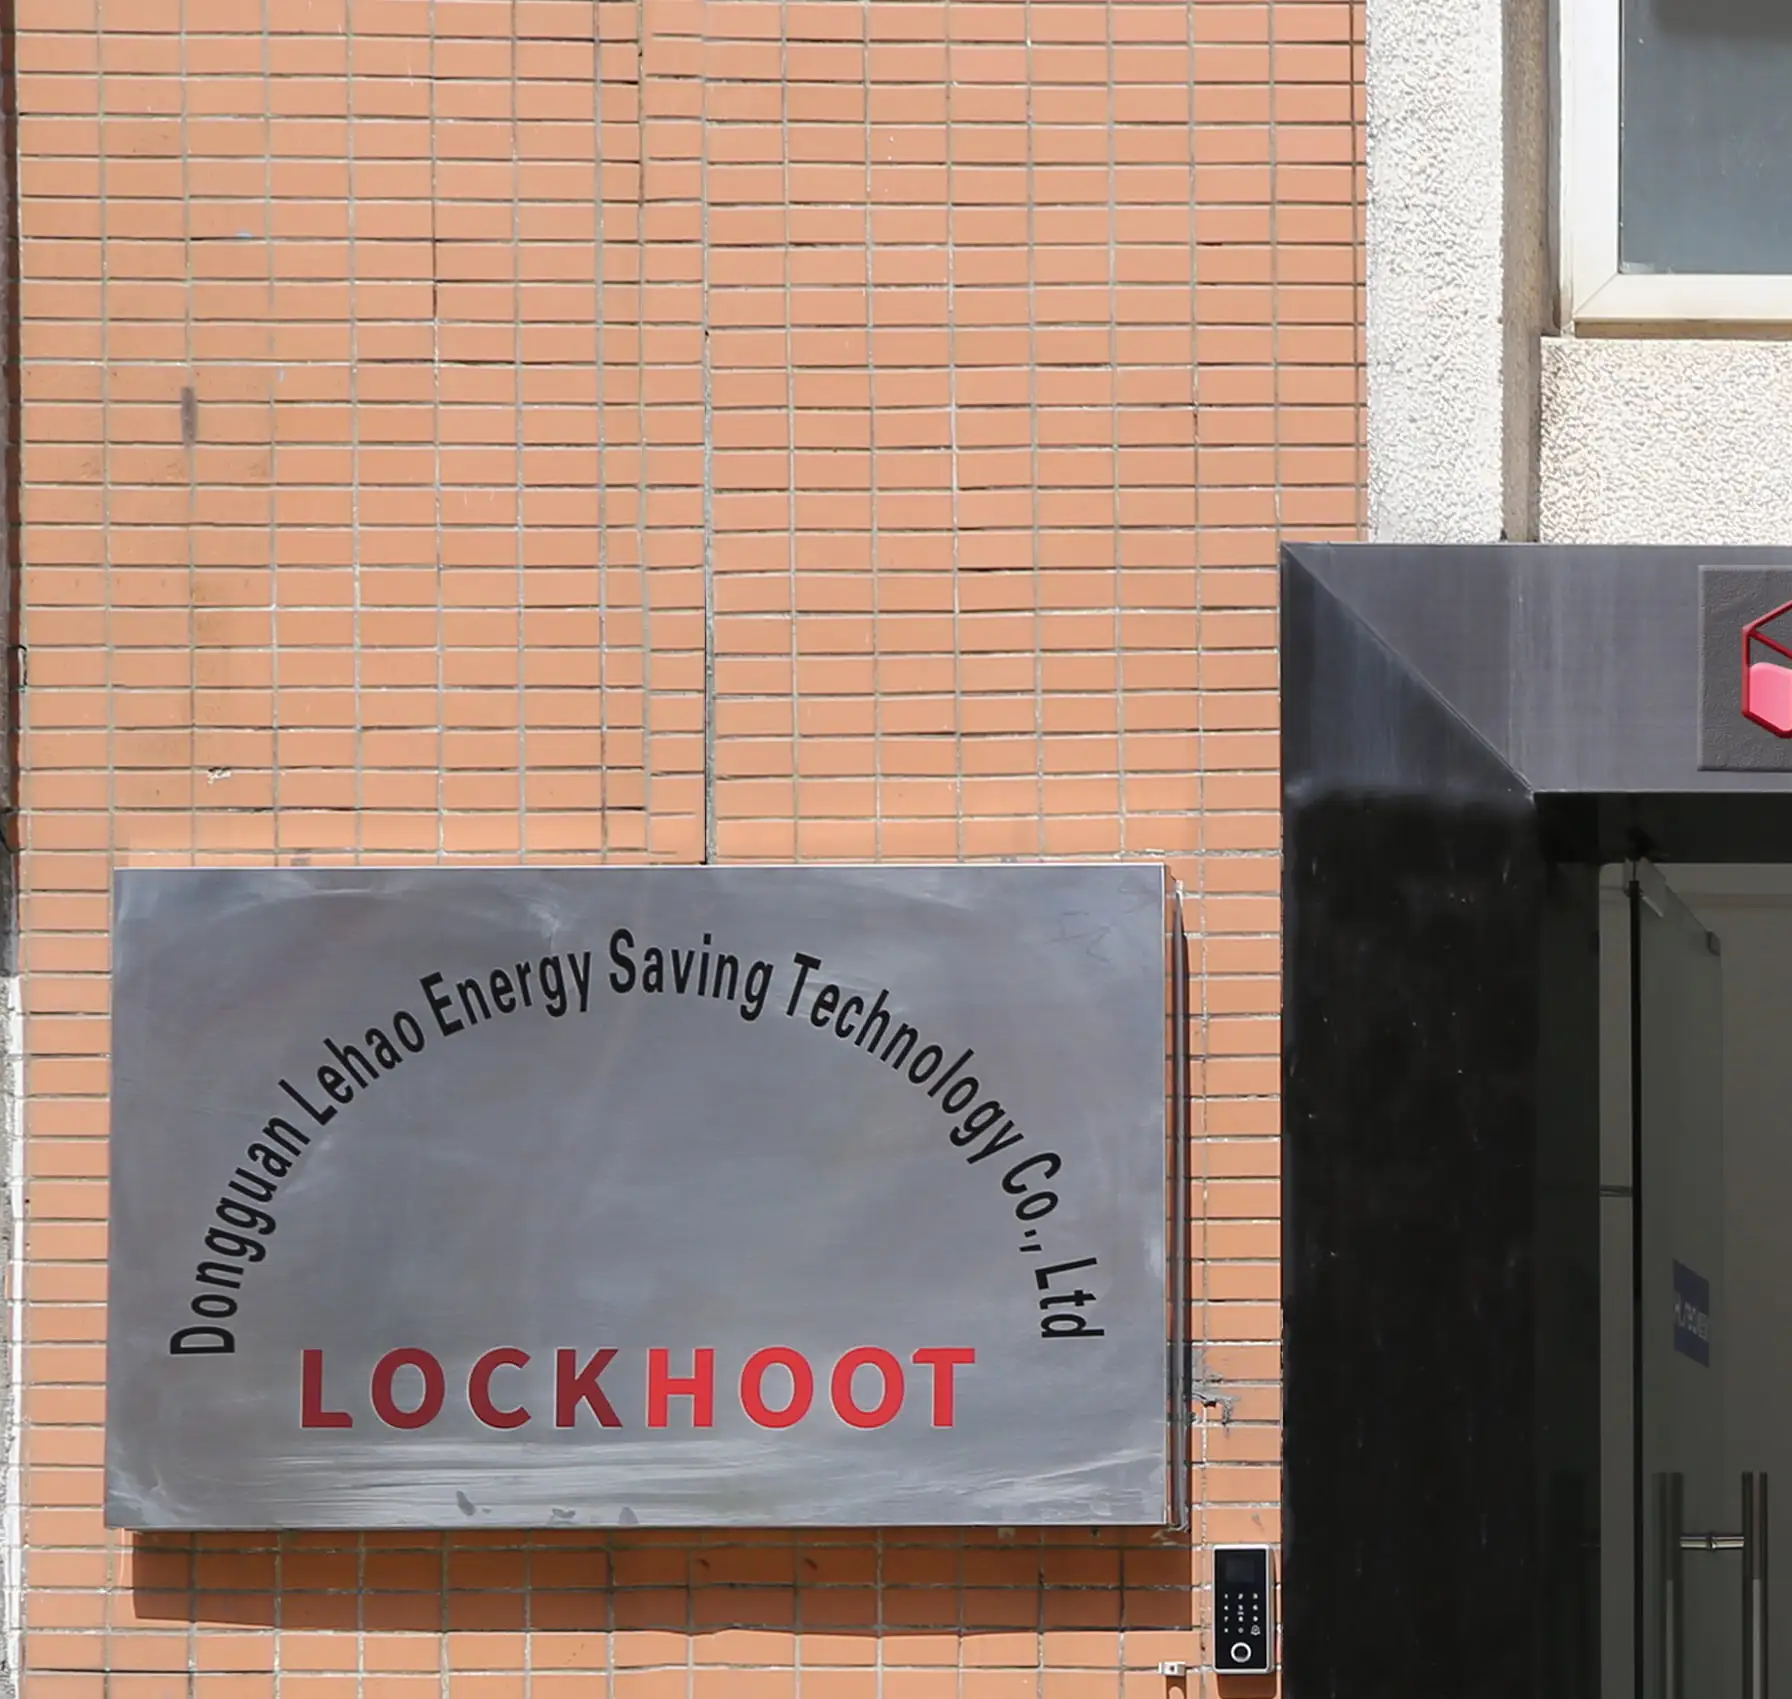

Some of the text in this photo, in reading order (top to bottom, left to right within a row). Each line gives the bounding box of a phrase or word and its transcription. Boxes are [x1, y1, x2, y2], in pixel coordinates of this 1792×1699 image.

[169, 927, 1106, 1356] Dongguan Lehao Energy Saving Technology Co., Ltd
[301, 1346, 977, 1429] LOCKHOOT
